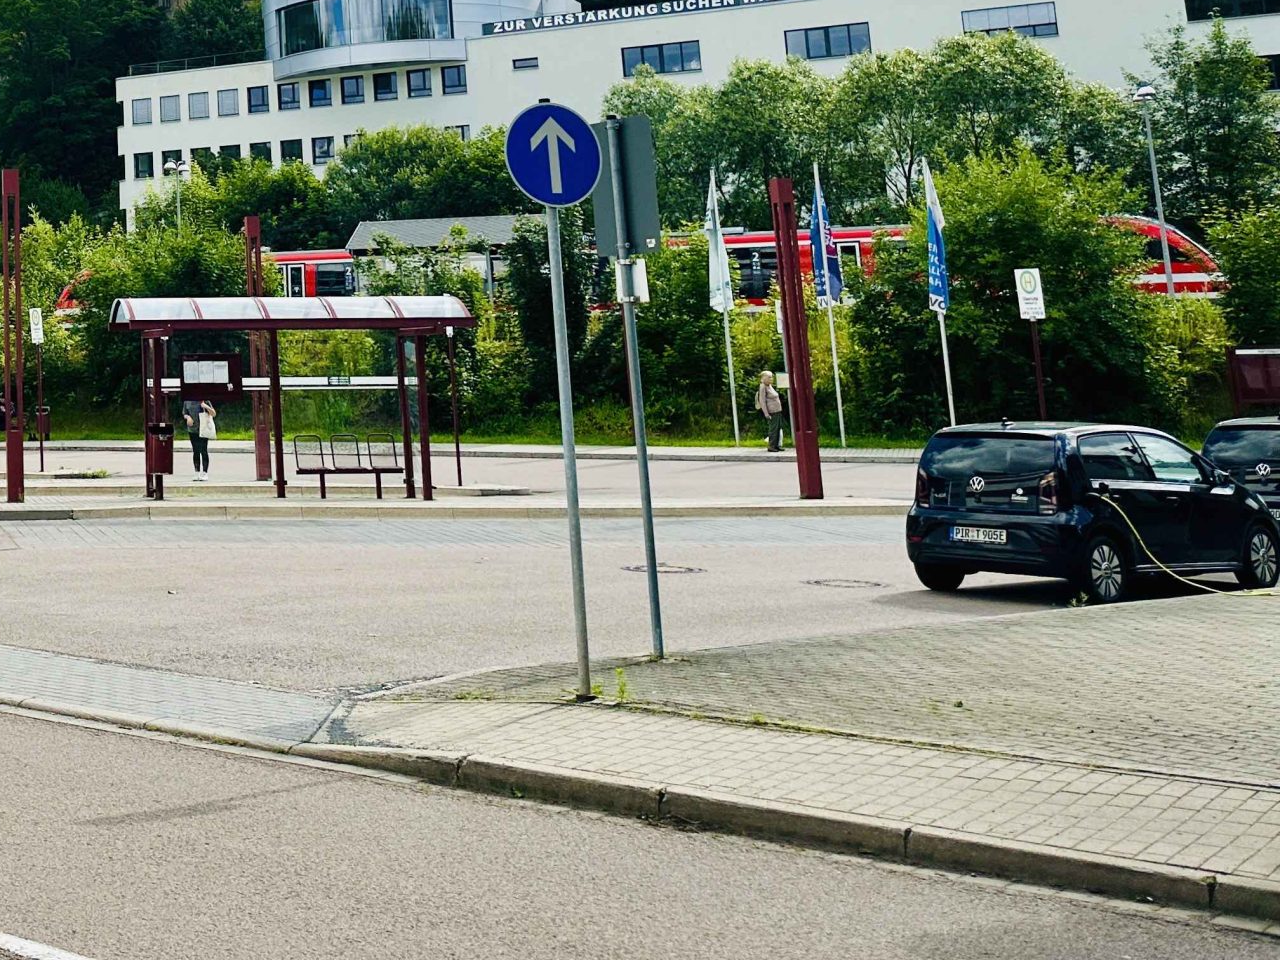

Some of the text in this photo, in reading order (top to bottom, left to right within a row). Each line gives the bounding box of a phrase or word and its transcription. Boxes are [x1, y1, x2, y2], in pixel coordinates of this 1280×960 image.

[493, 20, 527, 33] ZUR
[531, 3, 658, 29] VERSTÄRKUNG
[751, 252, 759, 261] 2
[345, 266, 352, 276] 2
[955, 527, 970, 538] PIR
[982, 529, 1005, 541] 905E
